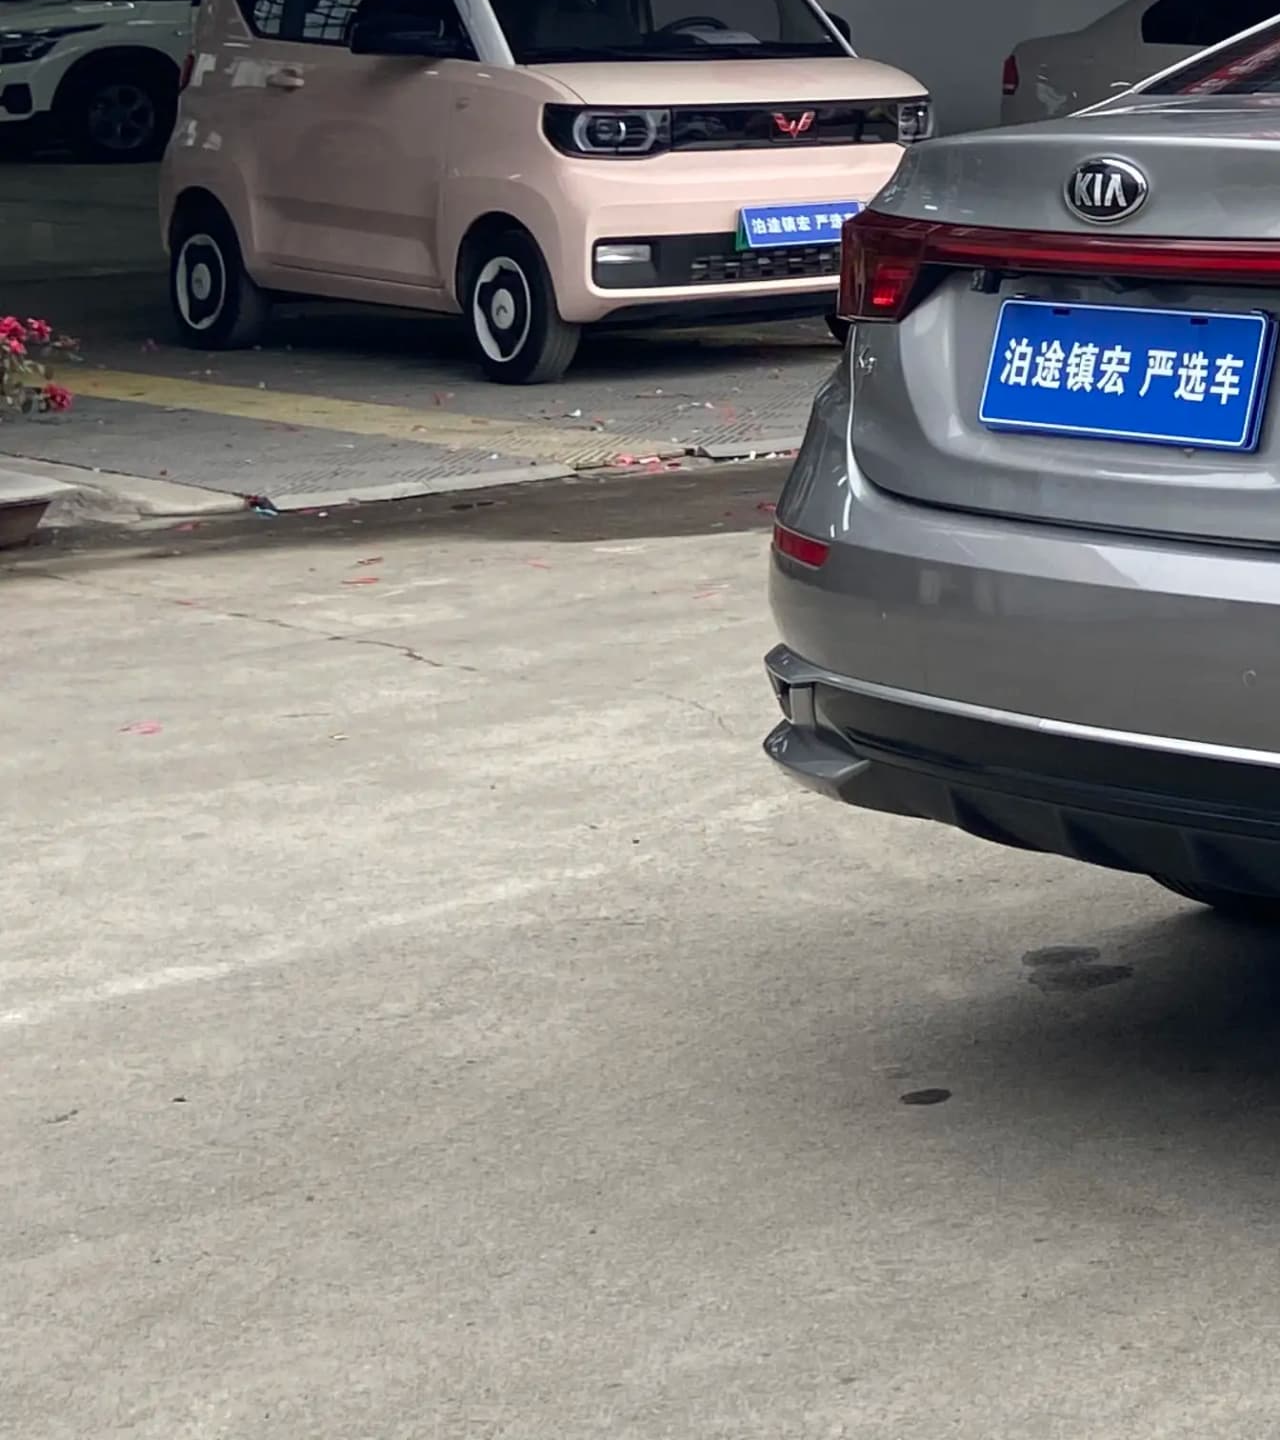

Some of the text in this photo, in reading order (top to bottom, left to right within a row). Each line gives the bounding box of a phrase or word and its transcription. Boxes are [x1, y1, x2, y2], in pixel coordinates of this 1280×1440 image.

[1074, 172, 1128, 209] KIA
[751, 215, 812, 235] 泊途镇宏
[1000, 337, 1244, 406] 泊途镇宏 严选车
